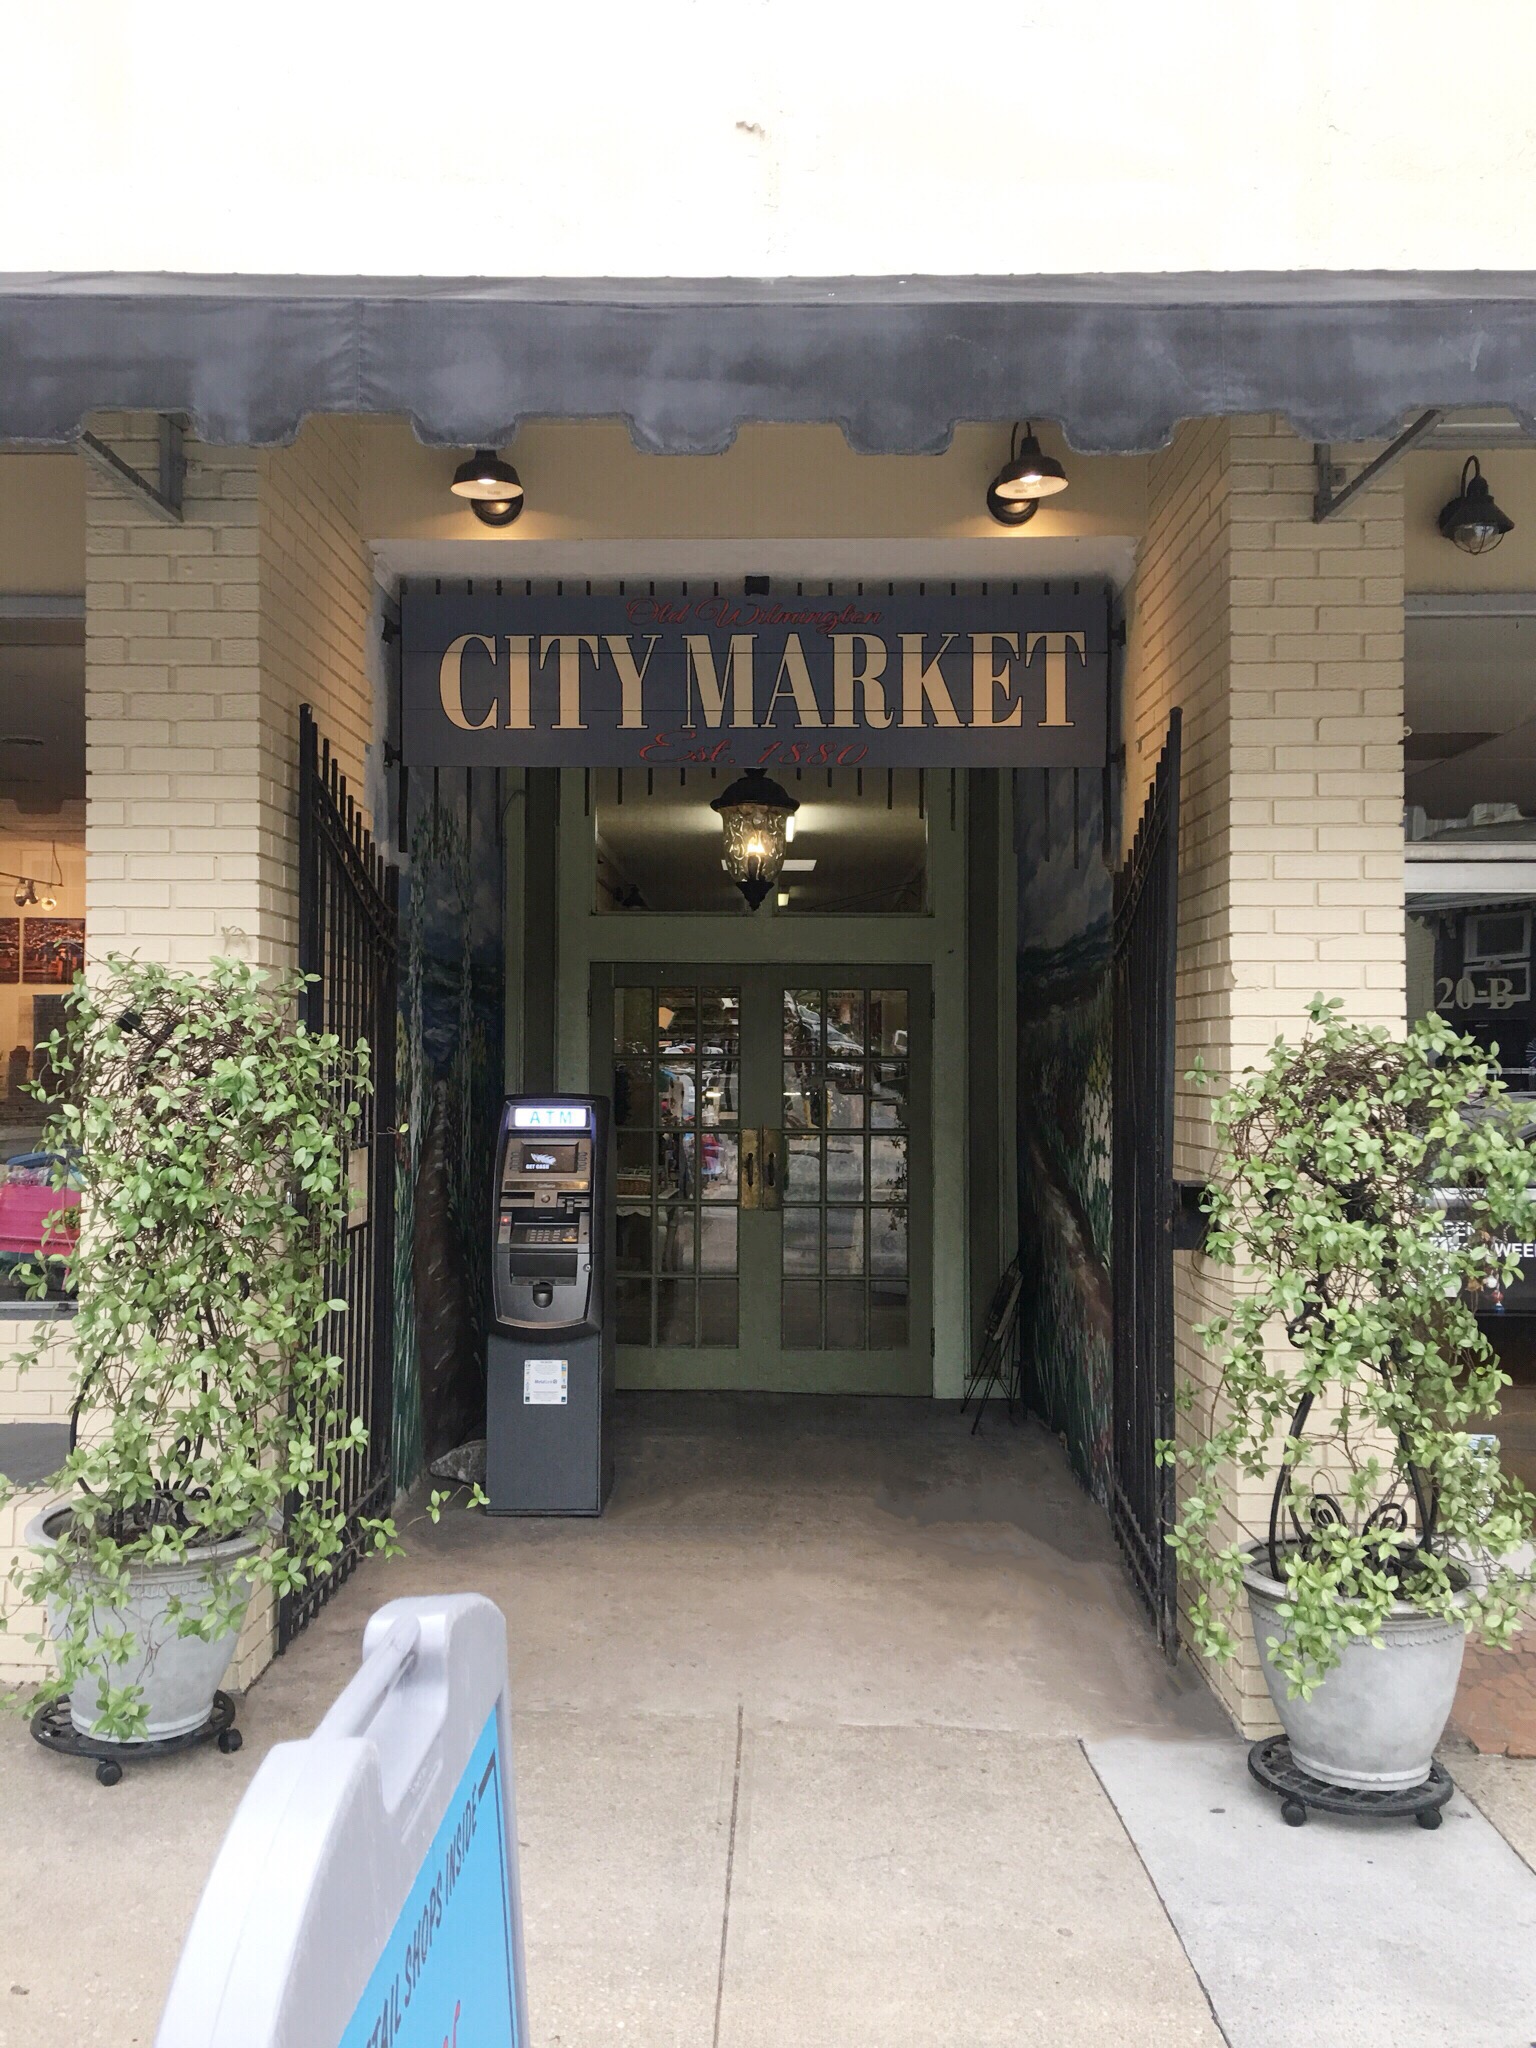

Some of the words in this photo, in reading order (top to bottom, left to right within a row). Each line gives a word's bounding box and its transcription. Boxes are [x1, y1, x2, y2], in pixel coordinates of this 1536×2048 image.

[625, 600, 693, 626] Old
[695, 597, 884, 634] Wilmington
[438, 633, 663, 731] CITY
[681, 631, 1087, 729] MARKET
[639, 731, 736, 763] Est.
[757, 741, 868, 766] 1880
[1436, 977, 1515, 1010] 20-B
[530, 1111, 572, 1124] ATM
[1494, 1242, 1536, 1258] WEE
[404, 1870, 443, 2009] SHOPS
[445, 1782, 478, 1906] INSIDE
